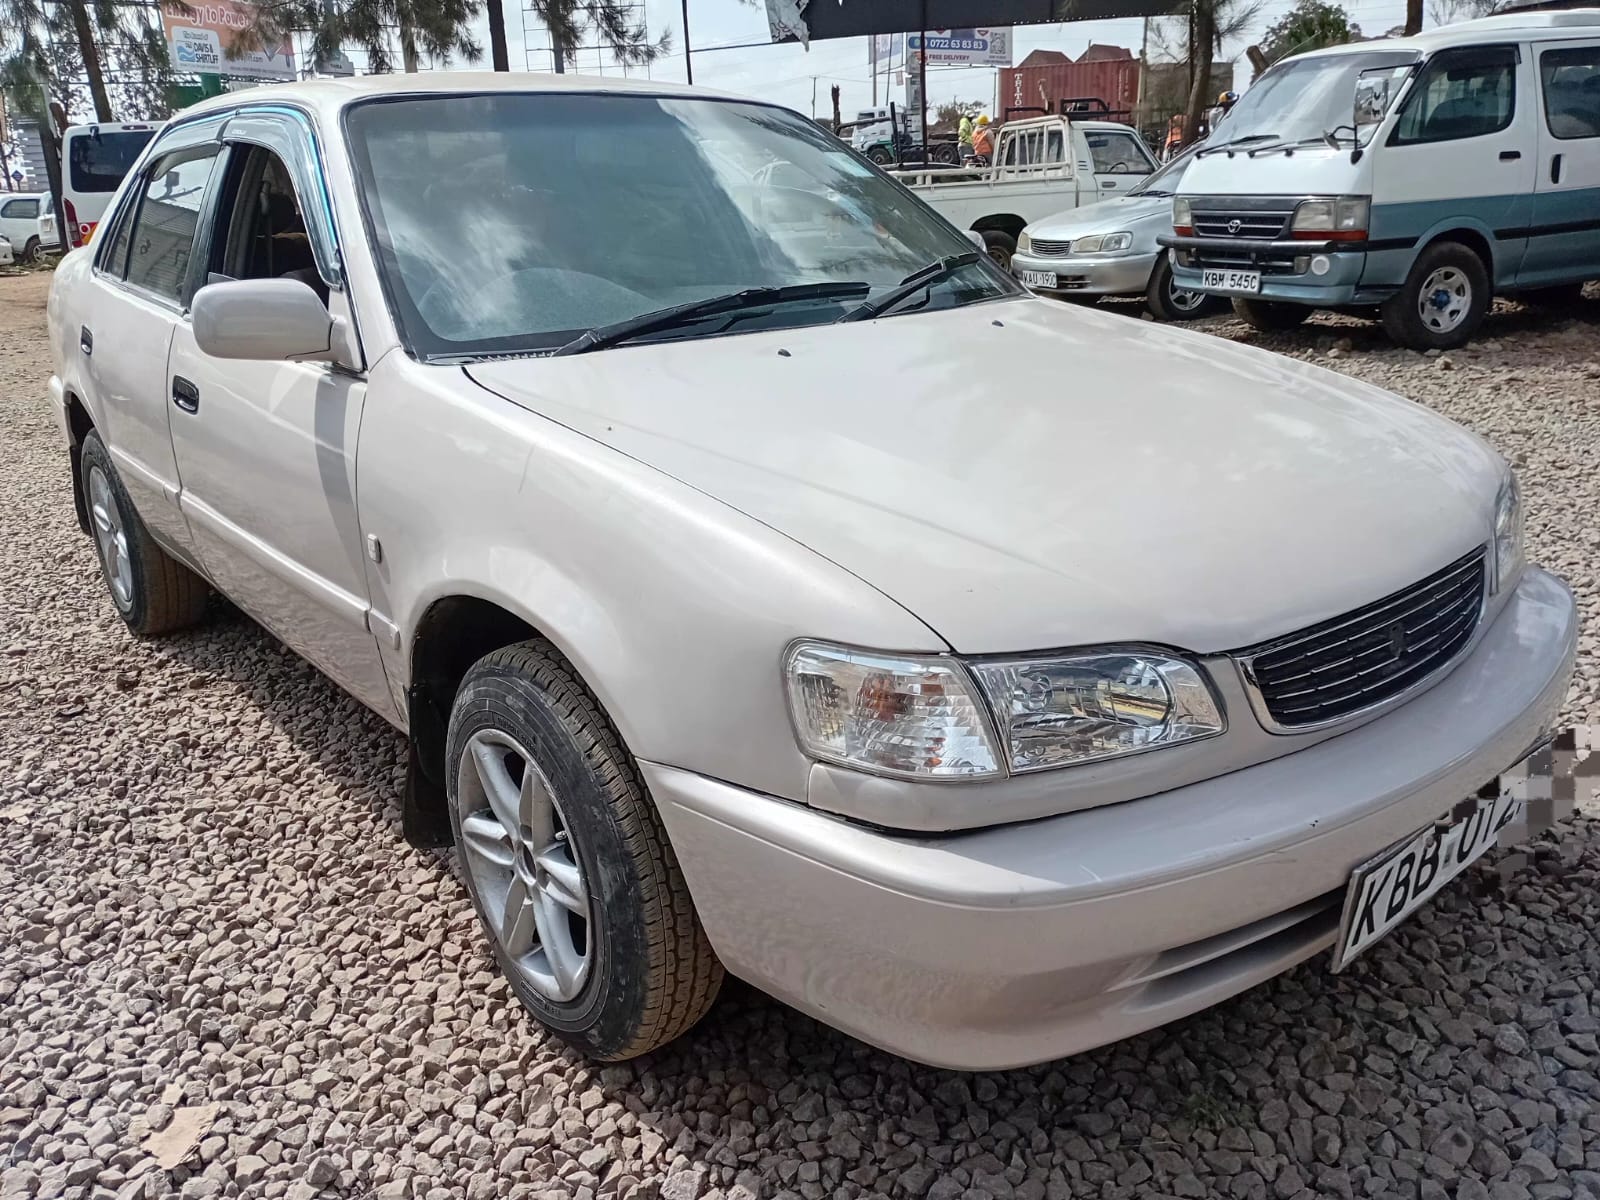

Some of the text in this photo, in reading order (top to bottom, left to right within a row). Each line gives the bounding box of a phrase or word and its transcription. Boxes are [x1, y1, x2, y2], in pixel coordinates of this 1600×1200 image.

[205, 5, 217, 24] to
[930, 39, 983, 49] 0722 63 83 83
[1014, 73, 1023, 112] TRITO
[1023, 272, 1038, 285] KAU
[1204, 271, 1257, 289] KBM 545C
[1351, 833, 1443, 947] KBB
